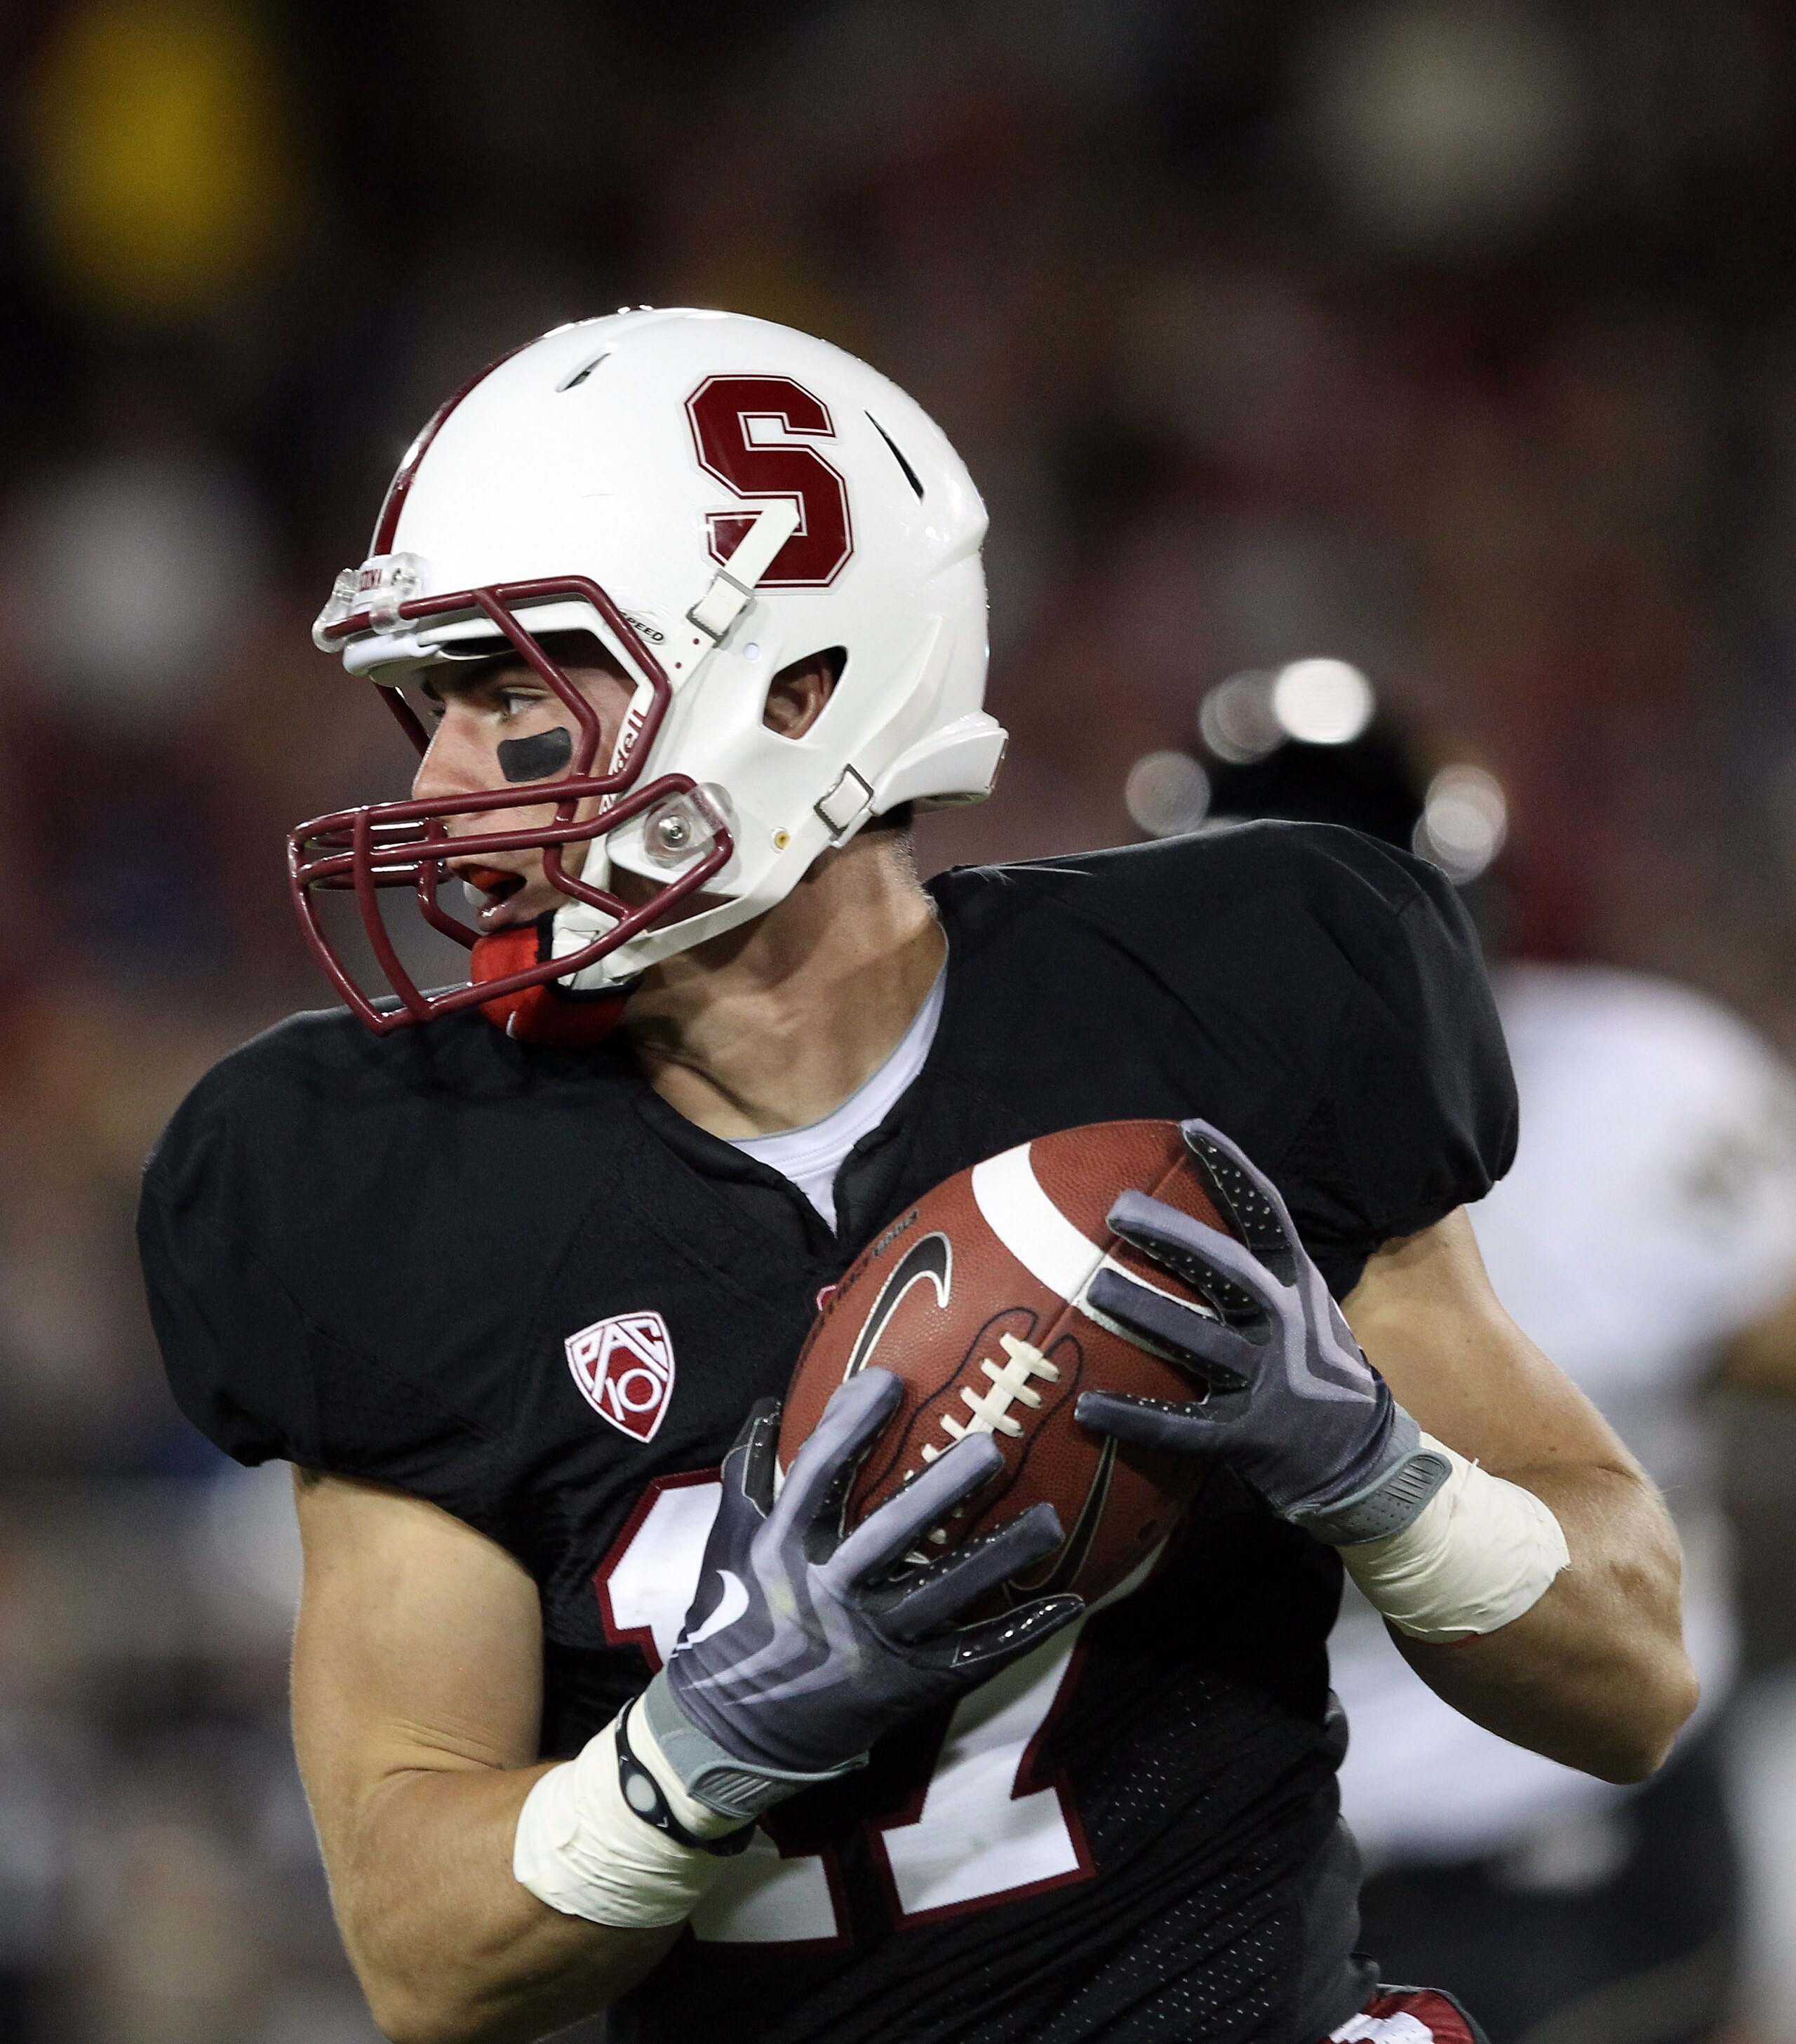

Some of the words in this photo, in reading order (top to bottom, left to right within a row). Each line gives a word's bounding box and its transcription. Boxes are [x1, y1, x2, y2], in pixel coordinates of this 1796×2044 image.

[685, 374, 854, 588] S
[619, 610, 664, 641] PEED
[571, 1319, 669, 1404] PAC
[605, 1368, 663, 1422] 10
